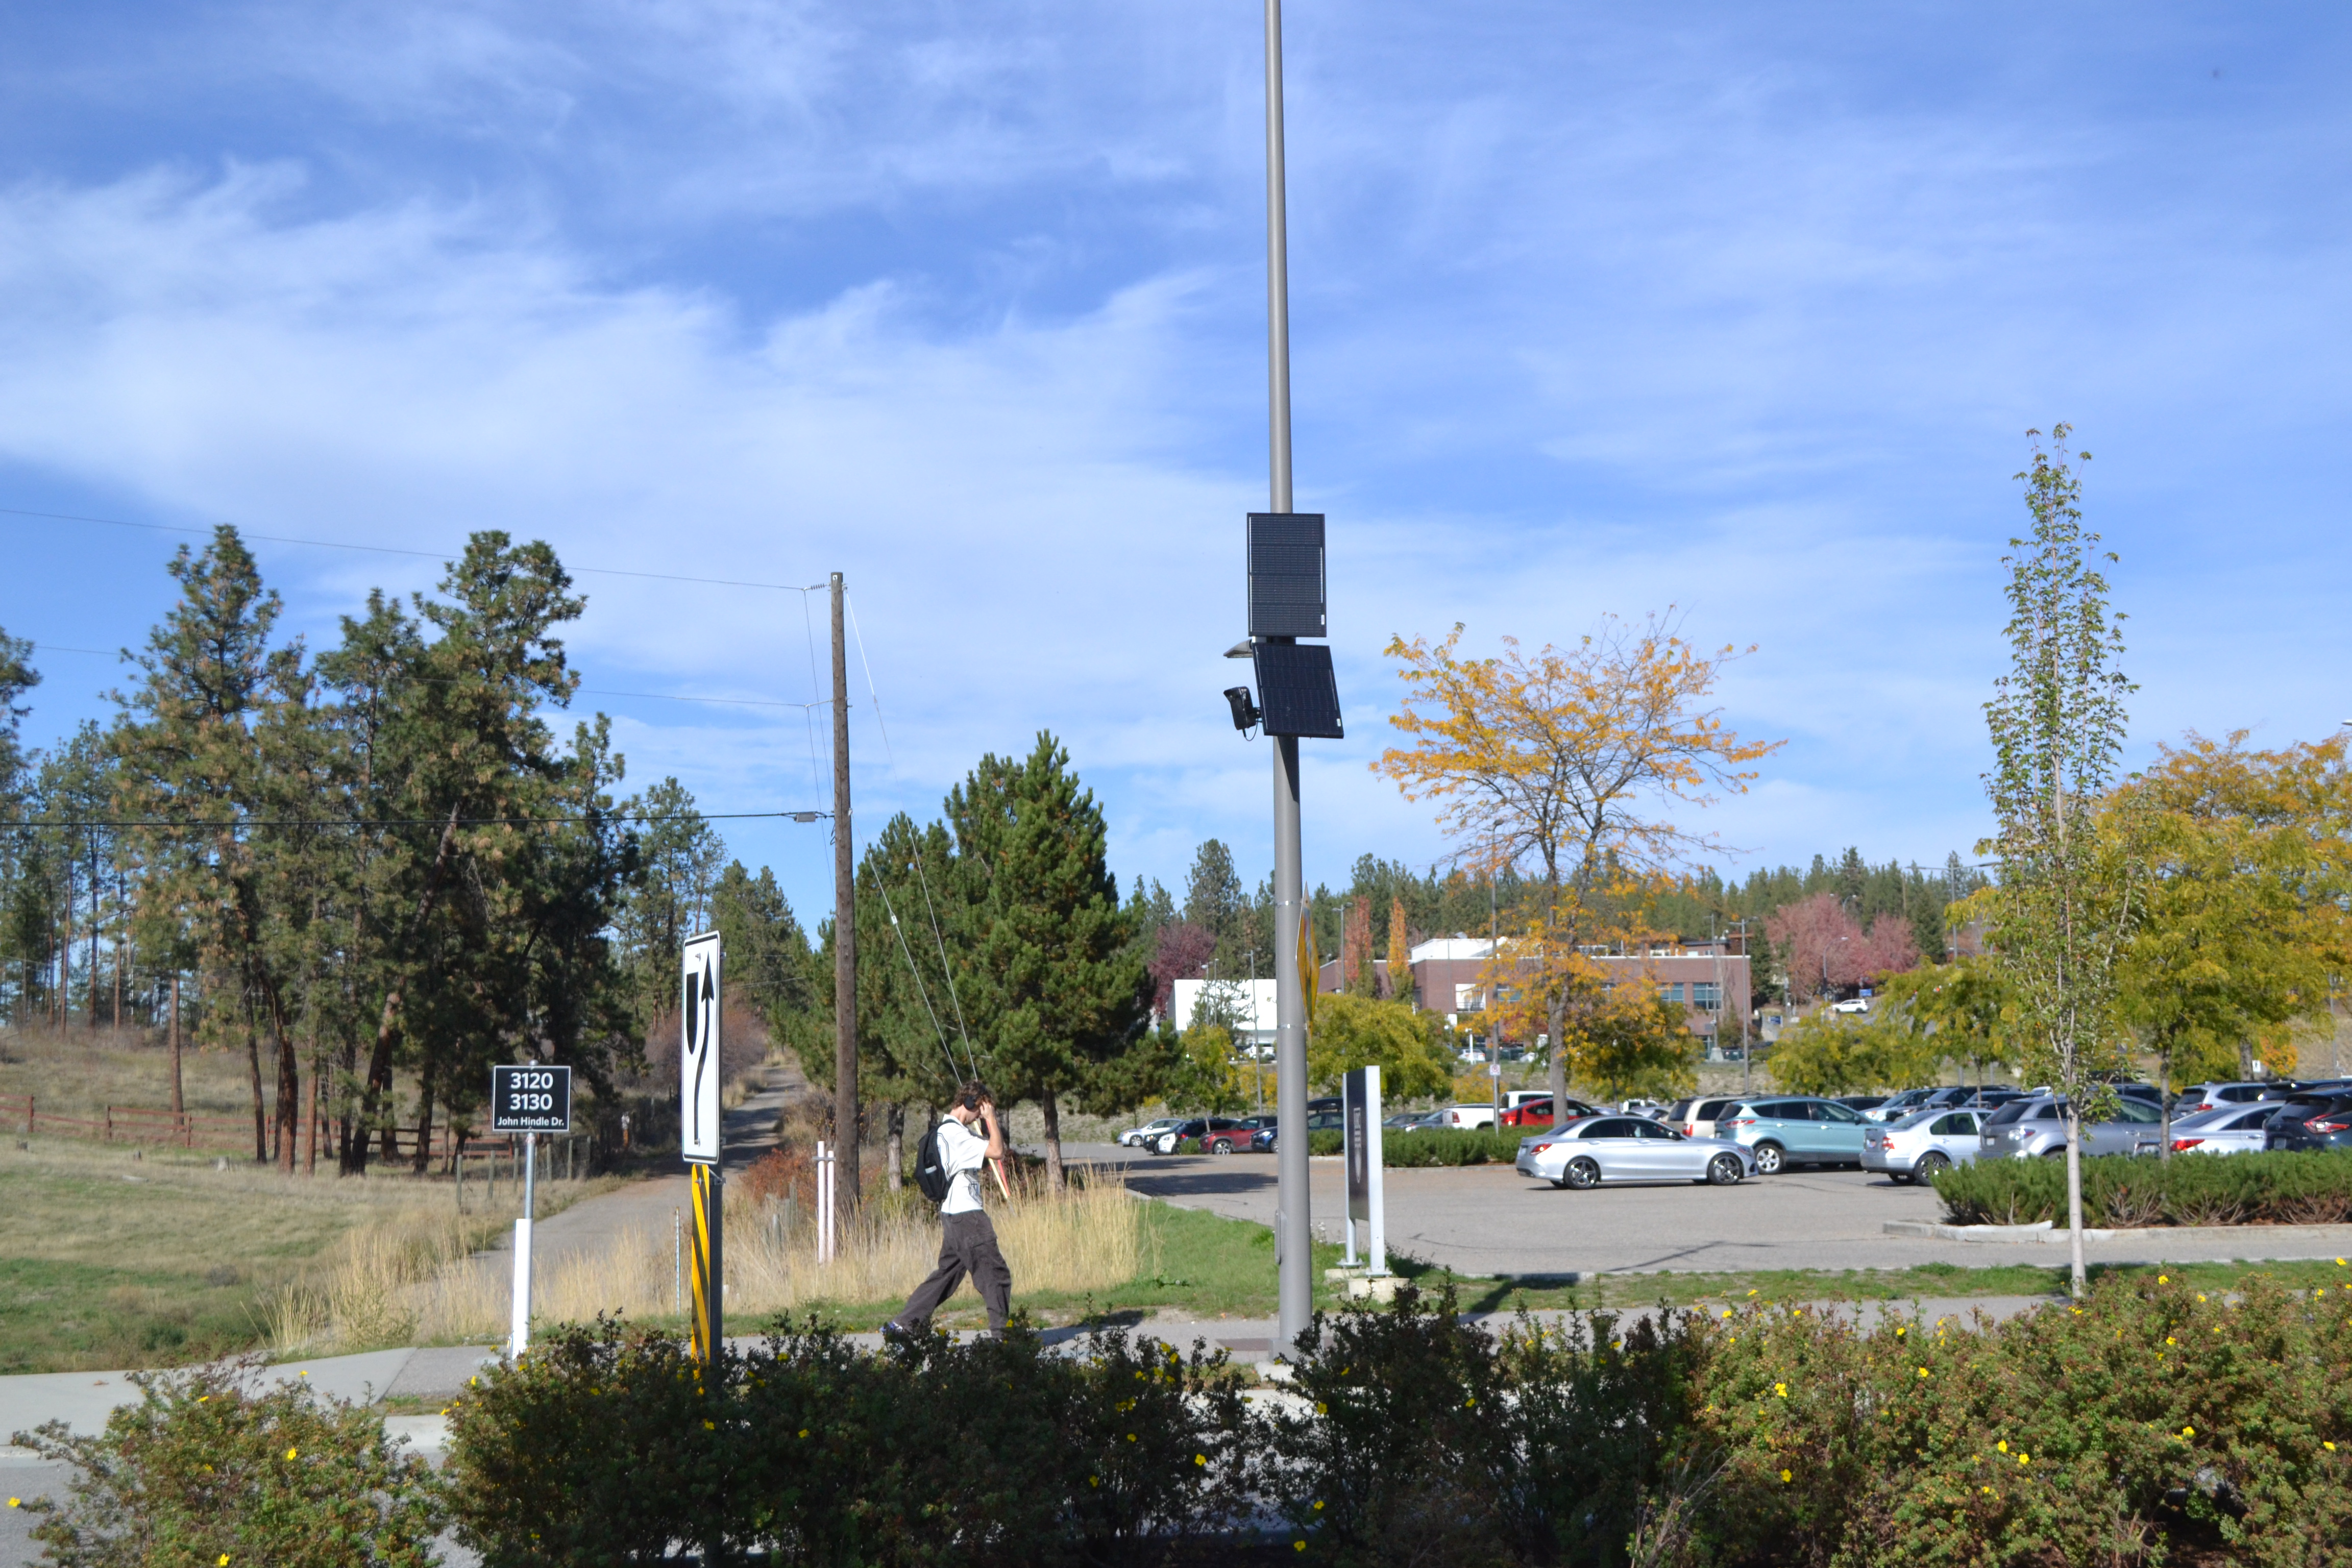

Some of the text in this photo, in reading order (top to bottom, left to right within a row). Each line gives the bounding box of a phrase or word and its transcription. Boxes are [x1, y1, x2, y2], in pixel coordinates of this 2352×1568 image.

[510, 1072, 553, 1089] 3120
[510, 1093, 553, 1110] 3130
[497, 1116, 565, 1126] John Hindle Dr.
